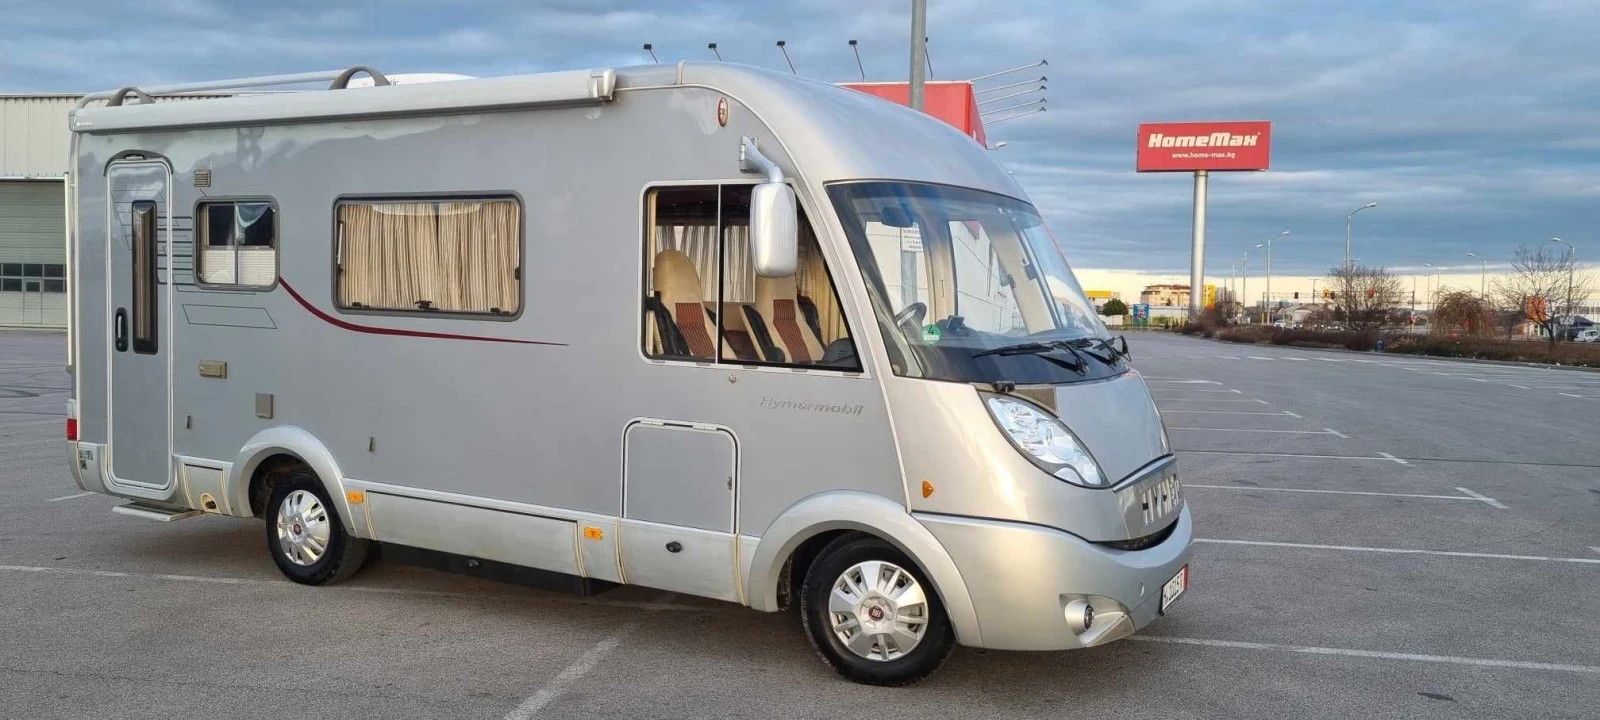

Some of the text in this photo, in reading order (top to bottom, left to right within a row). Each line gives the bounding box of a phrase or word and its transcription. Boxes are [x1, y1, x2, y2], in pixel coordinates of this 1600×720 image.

[1147, 132, 1258, 148] HomeMax
[1171, 151, 1236, 159] www.home-max.bg
[927, 325, 935, 335] 4
[759, 396, 864, 416] Hymermobil
[1141, 474, 1180, 526] HYMER
